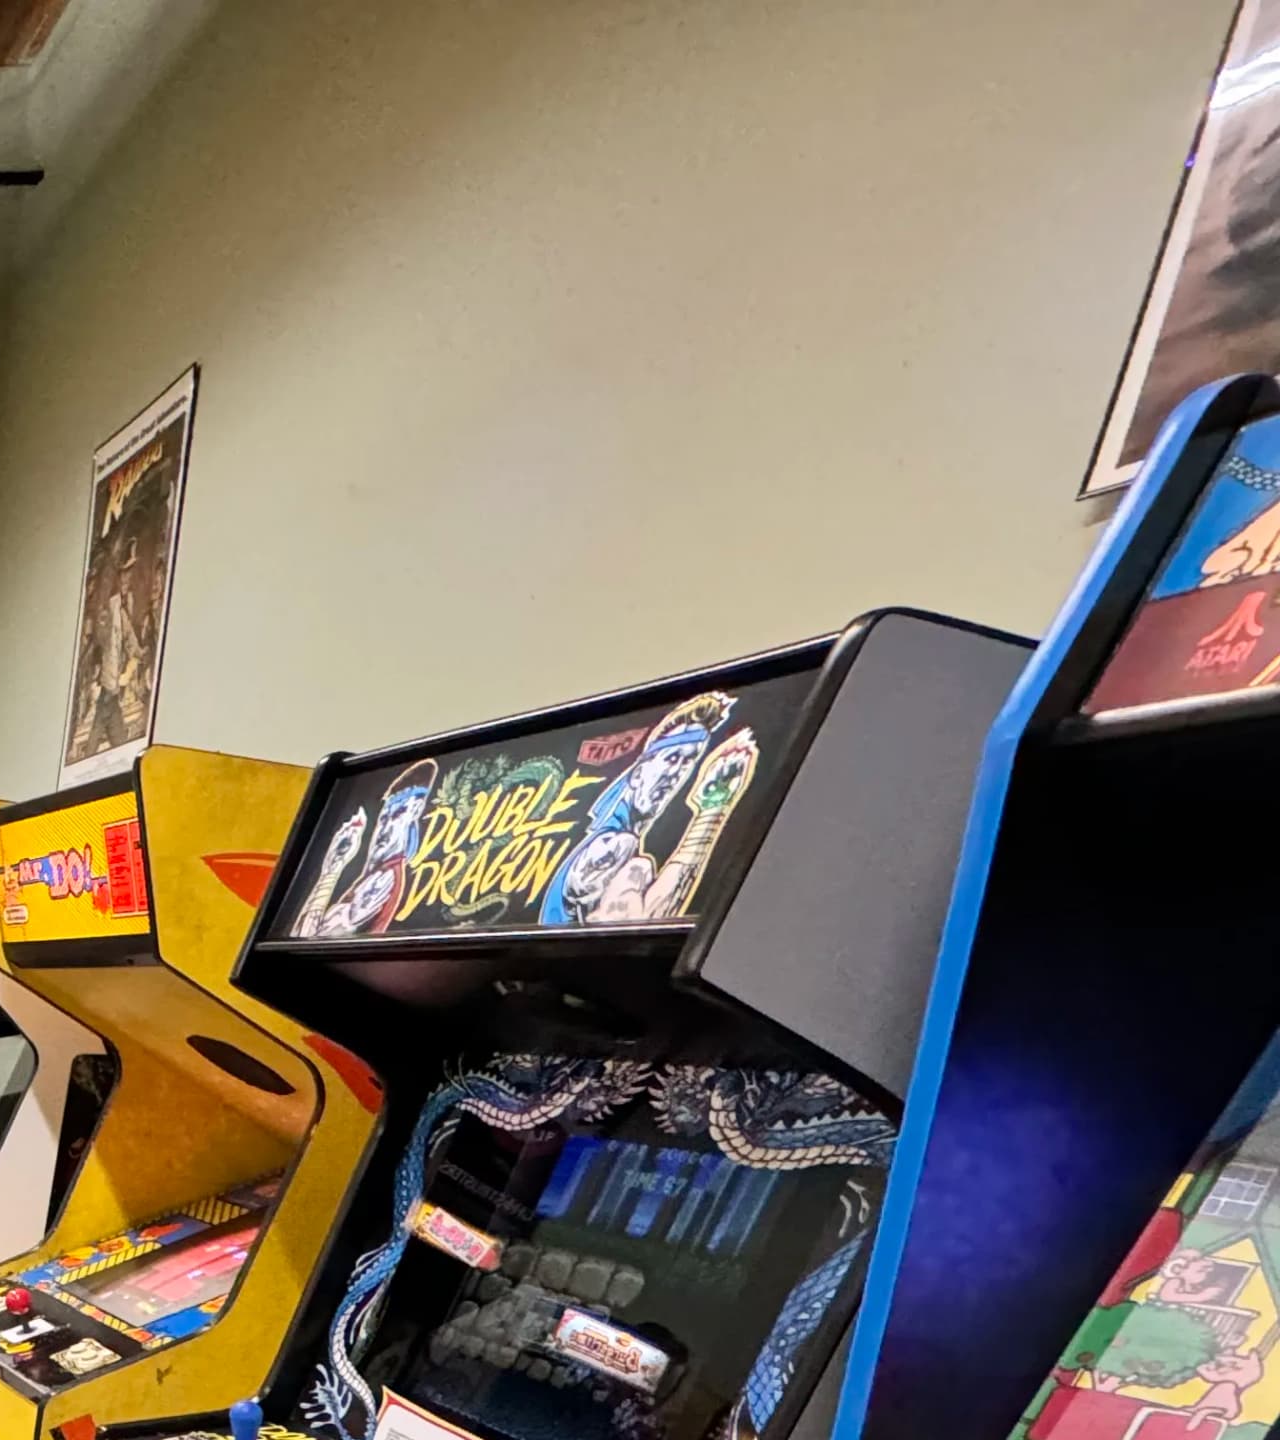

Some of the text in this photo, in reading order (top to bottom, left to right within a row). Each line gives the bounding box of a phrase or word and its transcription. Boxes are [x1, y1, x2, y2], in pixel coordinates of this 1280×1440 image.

[1185, 639, 1257, 670] ATARI
[588, 737, 633, 759] TAITO
[407, 771, 606, 867] DOUBLE
[395, 839, 572, 921] DRAGON
